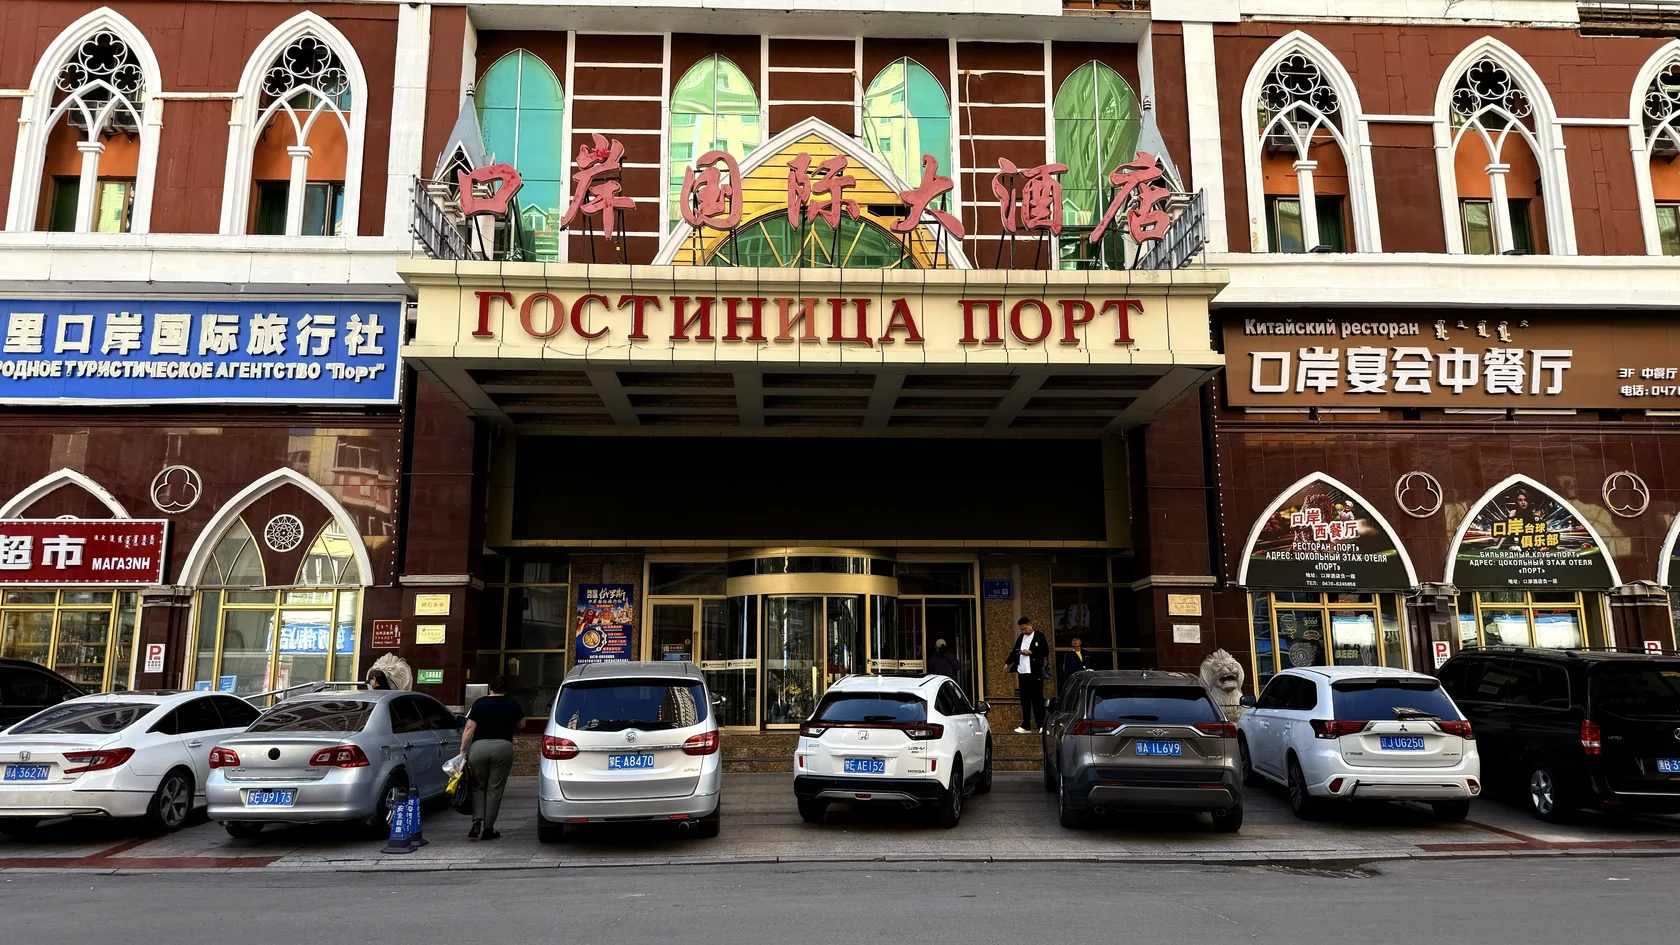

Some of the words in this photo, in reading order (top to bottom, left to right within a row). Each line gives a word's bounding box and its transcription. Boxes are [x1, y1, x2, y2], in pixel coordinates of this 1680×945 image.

[456, 132, 1173, 243] 口岸国际大酒店
[471, 290, 925, 347] ГОСТИНИЦА
[958, 298, 1145, 346] ПОРТ
[3, 312, 384, 356] 里口岸国际旅行社
[1243, 318, 1336, 336] Китайский
[1341, 322, 1420, 338] ресторан
[65, 360, 213, 379] ТУРИСТИЧЕСКОЕ
[216, 362, 320, 379] АГЕНТСТВО
[1248, 346, 1574, 395] 口岸宴会中餐厅
[1618, 368, 1635, 378] 3F
[1641, 367, 1678, 379] 中餐厅
[1291, 508, 1321, 526] 口岸
[1314, 521, 1358, 540] 西餐厅
[1493, 518, 1547, 536] 口岸台球
[1292, 542, 1330, 550] РЕСТОРАН
[1521, 534, 1559, 548] 俱乐部
[1266, 552, 1293, 561] АДРЕС:
[1294, 552, 1340, 561] ЦОКОЛЬНЫЙ
[1342, 554, 1362, 562] ЭТАЖ
[1364, 554, 1387, 562] ОТЕЛЯ
[1480, 551, 1529, 559] БИЛЬЯРДНЫЙ
[1498, 558, 1543, 566] ЦОКОЛЬНЫЙ
[149, 645, 162, 660] P
[1335, 649, 1358, 658] BEER
[1435, 643, 1447, 657] P
